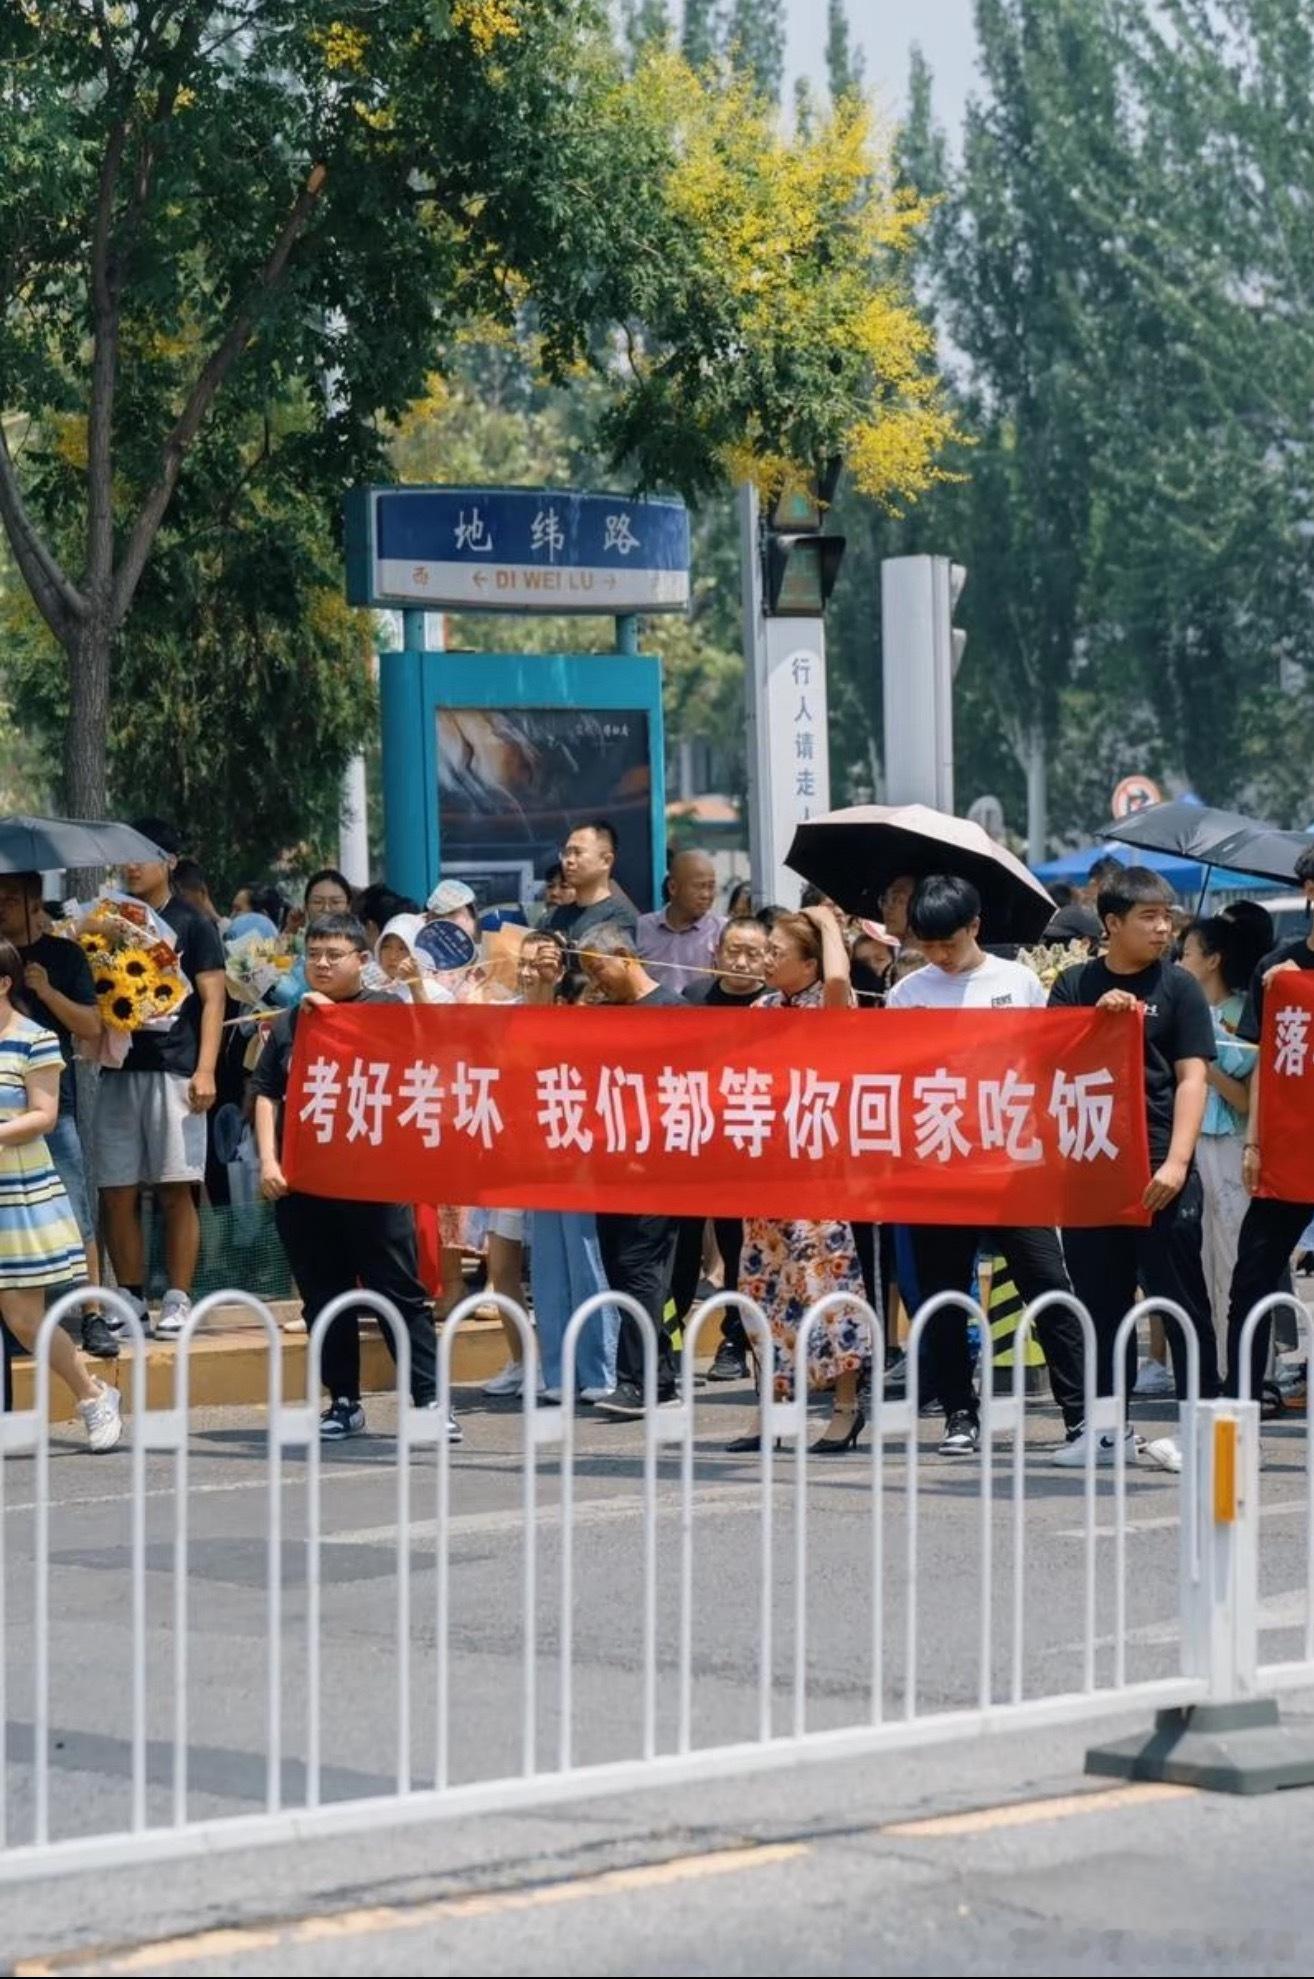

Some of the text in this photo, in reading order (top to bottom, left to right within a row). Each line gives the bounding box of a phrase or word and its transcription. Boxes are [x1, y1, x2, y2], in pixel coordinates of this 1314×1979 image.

[454, 506, 641, 563] 地纬路
[496, 569, 594, 590] DI WEI LU
[1273, 1005, 1314, 1077] 落
[299, 1056, 1120, 1164] 考好考坏 我们都等你回家吃饭
